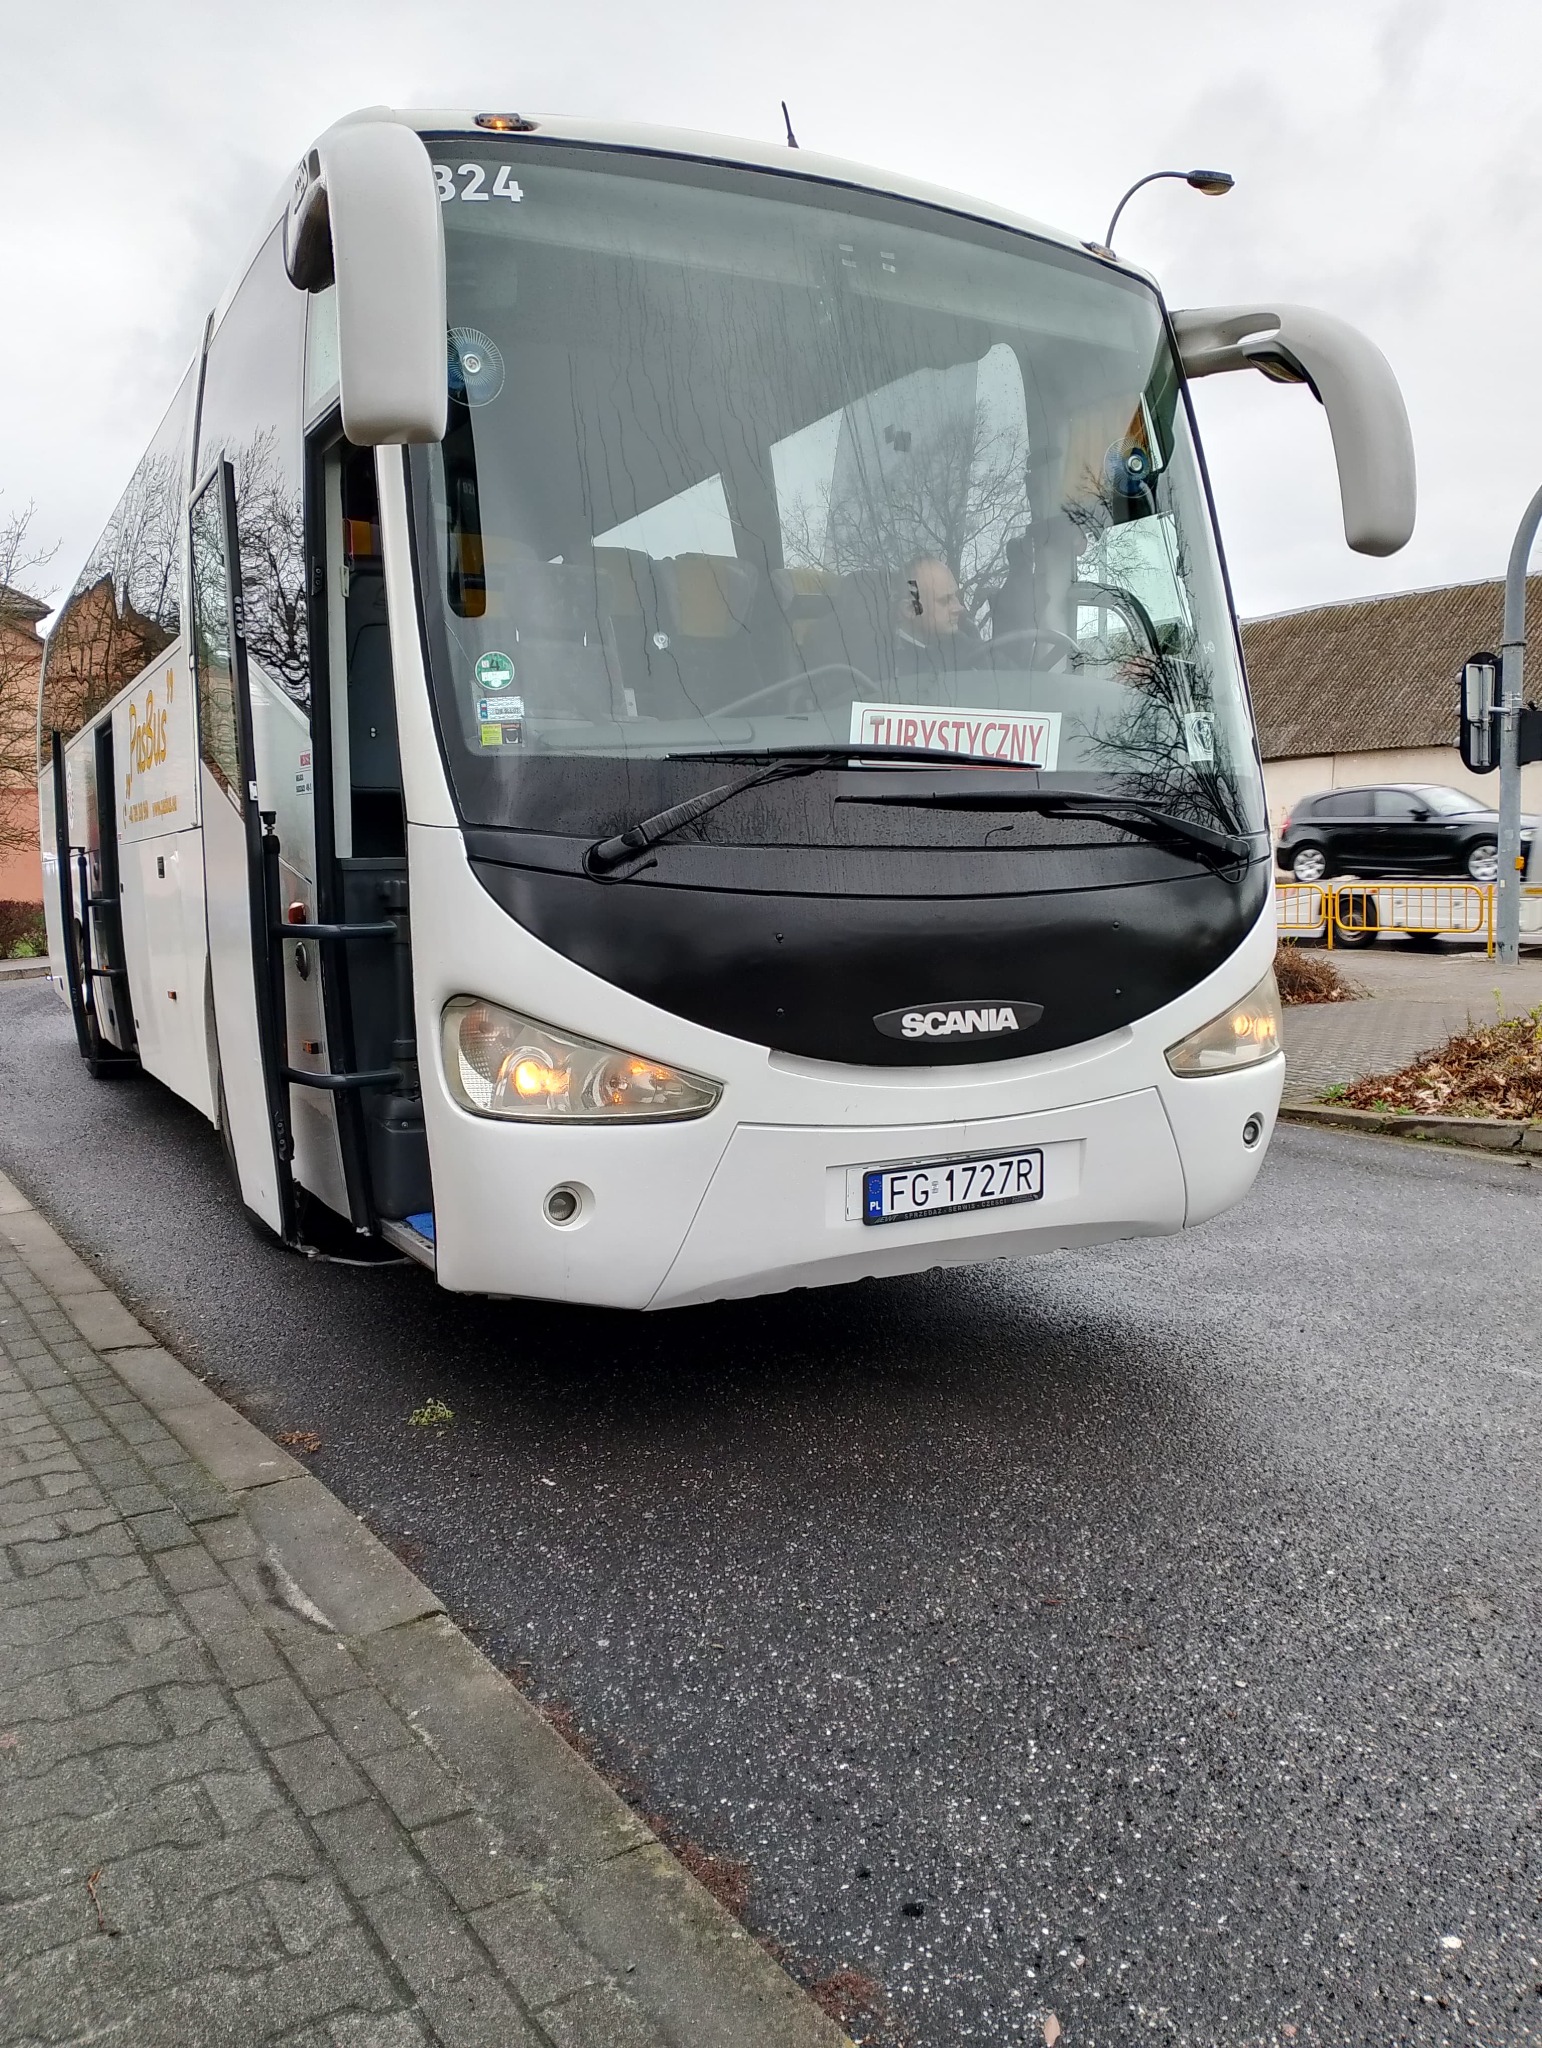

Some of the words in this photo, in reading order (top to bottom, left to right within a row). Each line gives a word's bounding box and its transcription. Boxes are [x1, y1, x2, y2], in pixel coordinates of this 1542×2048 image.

[869, 715, 1044, 762] TURYSTYCZNY
[901, 1007, 1019, 1037] SCANIA
[890, 1173, 930, 1211] FG
[945, 1158, 1033, 1202] 1727R
[869, 1201, 881, 1211] PL
[948, 1203, 976, 1213] SERWIS
